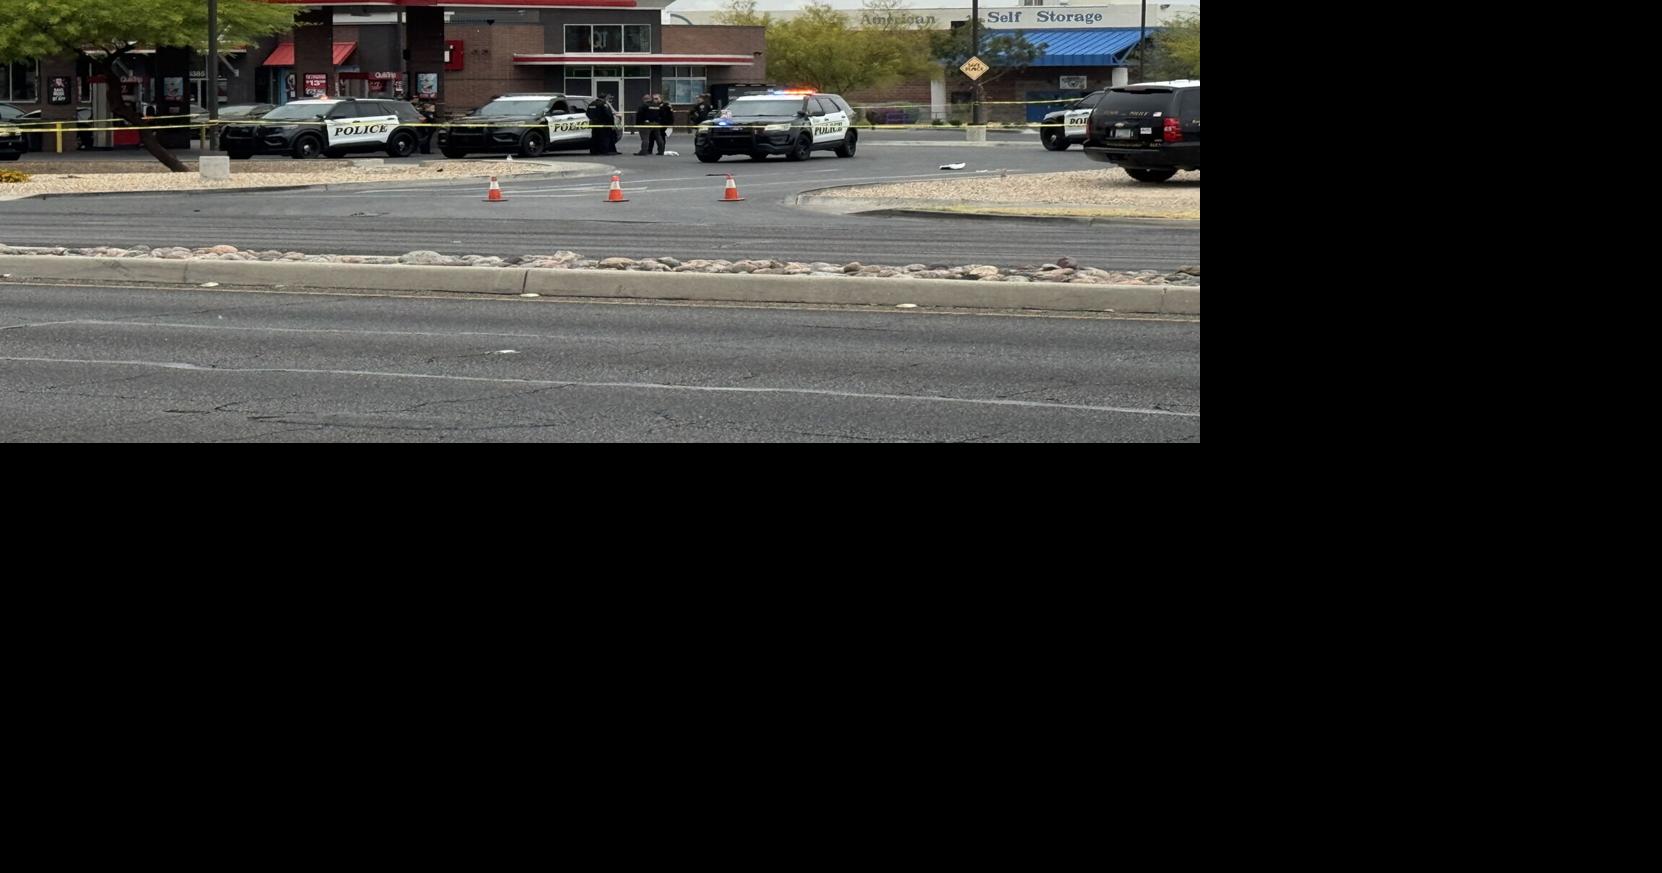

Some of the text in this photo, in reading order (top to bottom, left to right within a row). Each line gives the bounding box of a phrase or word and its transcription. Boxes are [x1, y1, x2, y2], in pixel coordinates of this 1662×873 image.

[987, 11, 1022, 23] Self
[1037, 10, 1103, 25] Storage
[553, 121, 589, 132] POLIC
[1069, 117, 1089, 127] POL
[335, 124, 388, 136] POLICE
